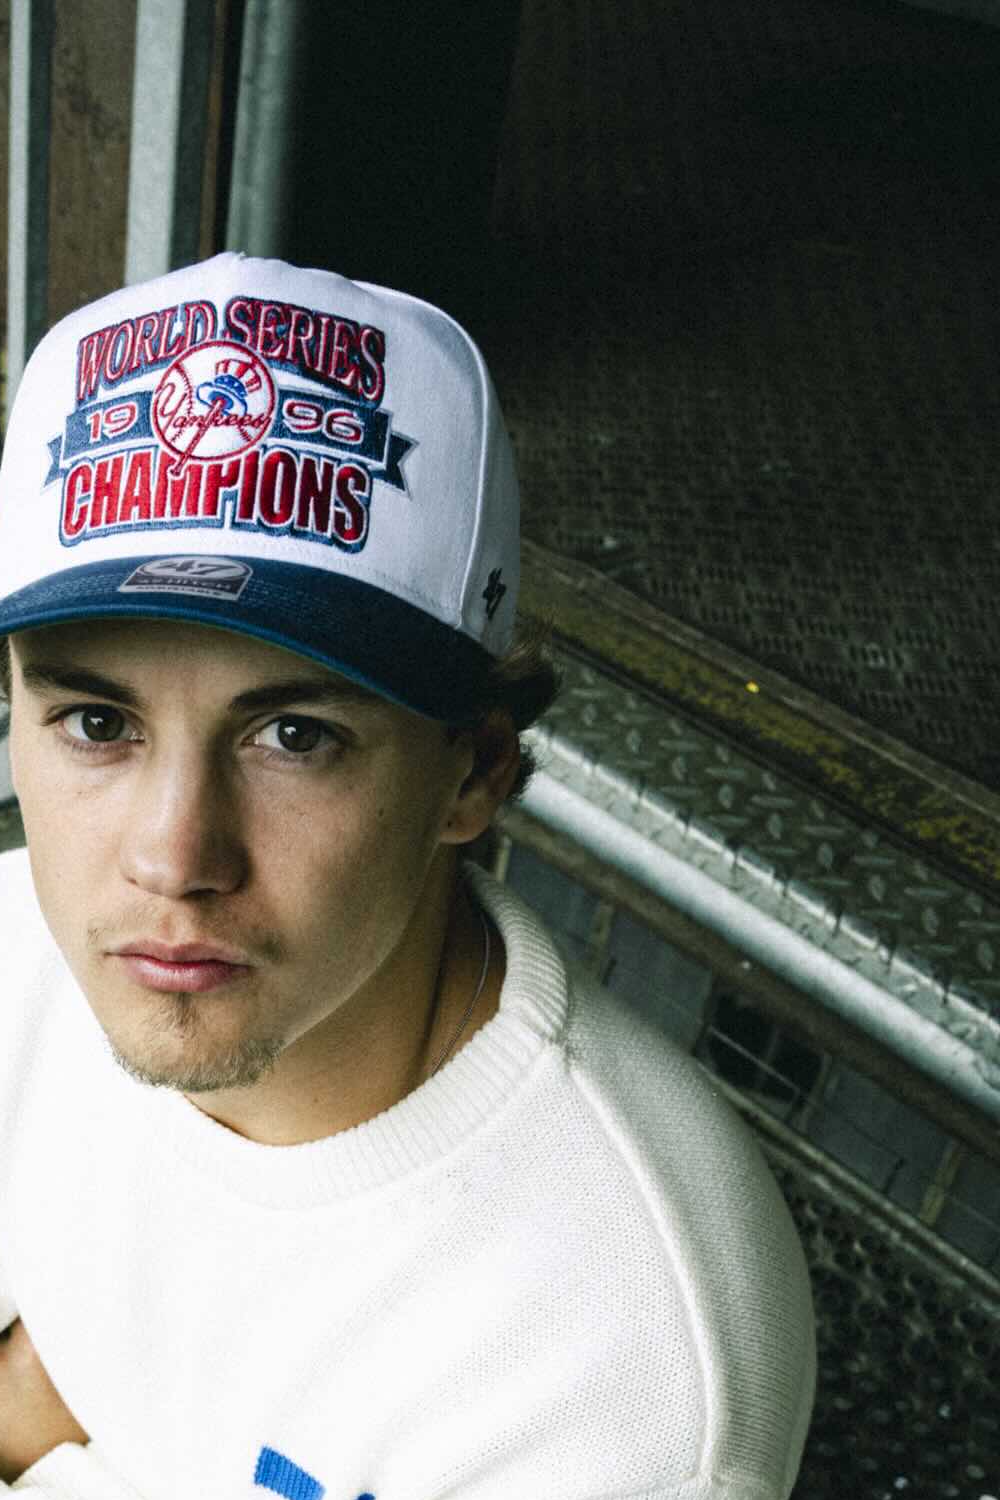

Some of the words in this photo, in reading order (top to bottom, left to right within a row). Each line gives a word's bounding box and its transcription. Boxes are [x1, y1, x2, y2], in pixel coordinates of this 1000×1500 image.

[76, 301, 216, 401] WORLD
[224, 298, 386, 405] SERIES
[86, 402, 139, 443] 19
[282, 399, 365, 444] 96
[155, 382, 273, 436] Yankees
[60, 448, 370, 545] CHAMPIONS
